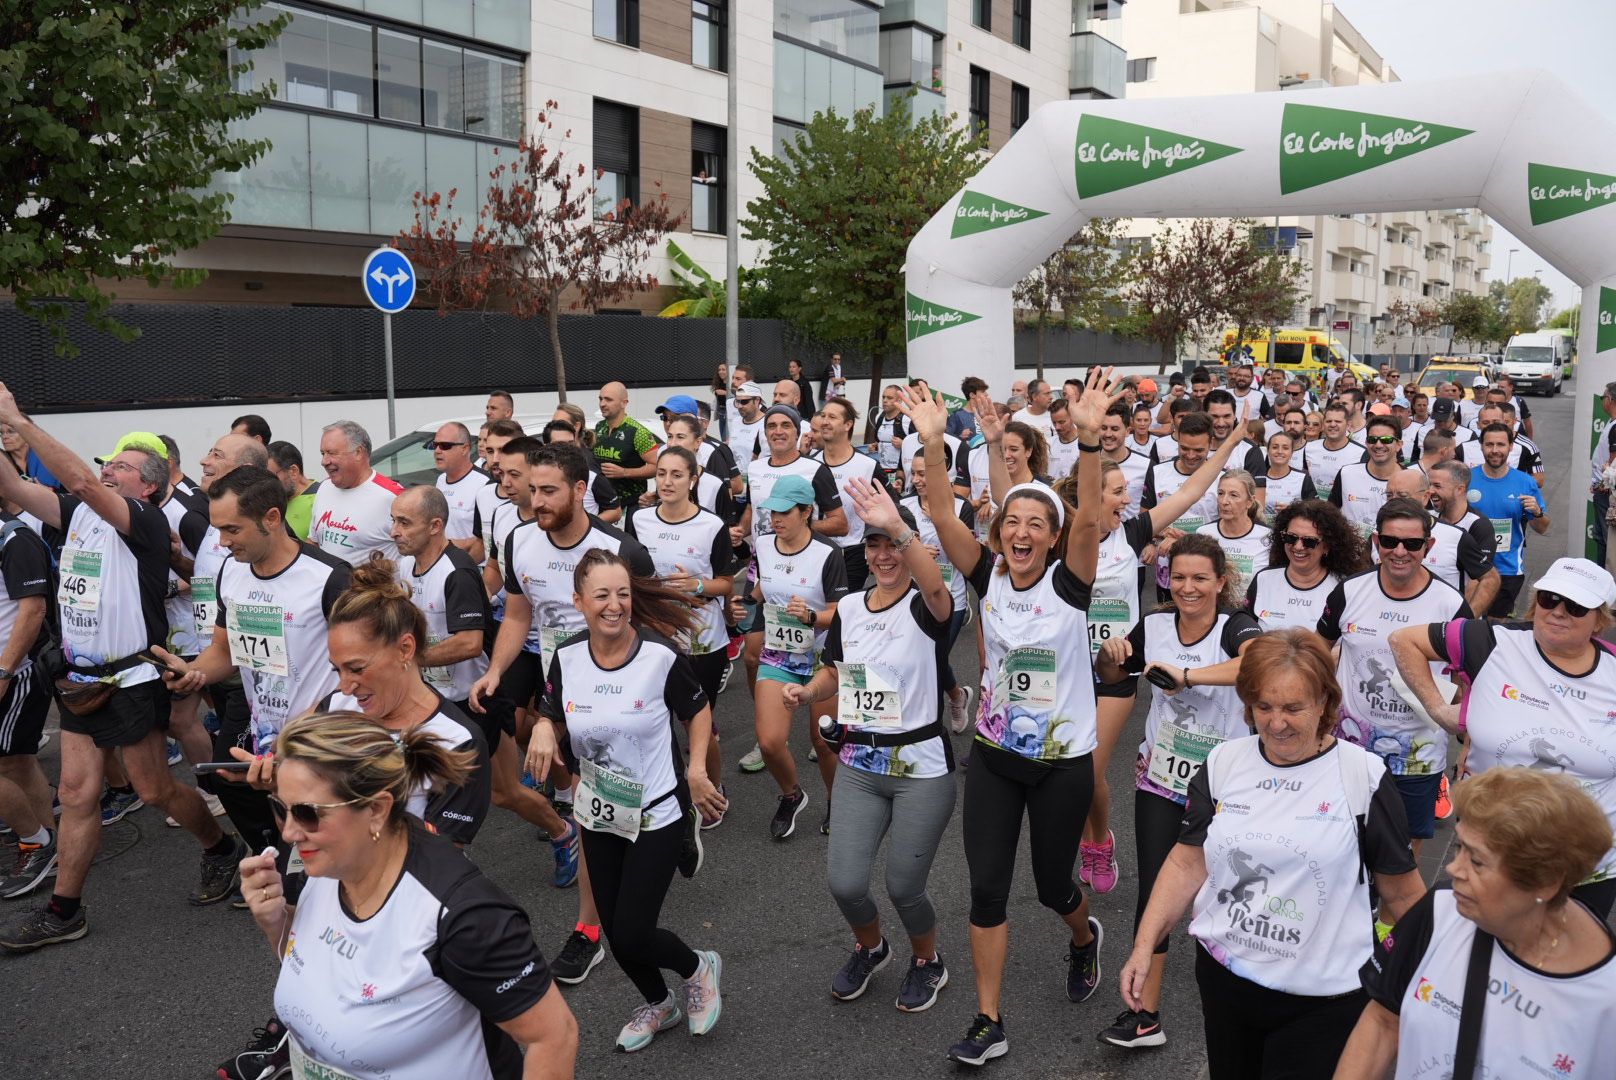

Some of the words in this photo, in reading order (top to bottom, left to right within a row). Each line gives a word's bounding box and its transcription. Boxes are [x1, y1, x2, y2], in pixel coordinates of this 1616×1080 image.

[1283, 132, 1304, 154] El
[1309, 131, 1355, 152] Corte
[1357, 122, 1430, 157] Inglés
[1078, 142, 1097, 162] El
[1100, 143, 1139, 162] Corte
[1142, 136, 1206, 169] Inglés
[1531, 186, 1546, 200] El
[1549, 184, 1582, 199] Corte
[957, 206, 967, 218] El
[967, 207, 989, 217] Corte
[990, 203, 1029, 221] Inglés
[928, 307, 962, 326] Inglés
[1600, 311, 1611, 325] El
[1593, 418, 1605, 433] El
[658, 532, 681, 541] JOYLU
[548, 561, 575, 572] JOYLU
[63, 575, 87, 596] 446
[248, 590, 274, 602] JOYLU
[1287, 598, 1312, 607] JOYLU
[249, 606, 282, 614] POPULAR
[1379, 611, 1409, 623] JOYLU
[776, 627, 804, 643] 416
[239, 634, 270, 657] 171
[594, 683, 623, 695] JOYLU
[854, 690, 885, 711] 132
[1520, 693, 1550, 706] Diputación
[1531, 727, 1547, 736] DE
[1550, 727, 1575, 739] ORO
[1580, 735, 1594, 747] DE
[608, 774, 642, 791] POPULAR
[1256, 777, 1302, 793] JOYLU
[591, 797, 615, 822] 93
[1223, 802, 1251, 810] Diputación
[1226, 834, 1241, 846] DE
[1245, 832, 1272, 841] ORO
[1276, 835, 1290, 848] DE
[1294, 845, 1308, 859] LA
[1308, 860, 1327, 906] CIUDAD
[1230, 908, 1301, 945] Peñas
[319, 926, 360, 960] JOYLU
[1225, 932, 1297, 960] cordobesas
[496, 961, 535, 994] CÓRDOBA
[1434, 991, 1463, 1012] Diputac
[291, 1006, 313, 1026] ORO
[315, 1023, 329, 1042] DE
[331, 1041, 346, 1060] LA
